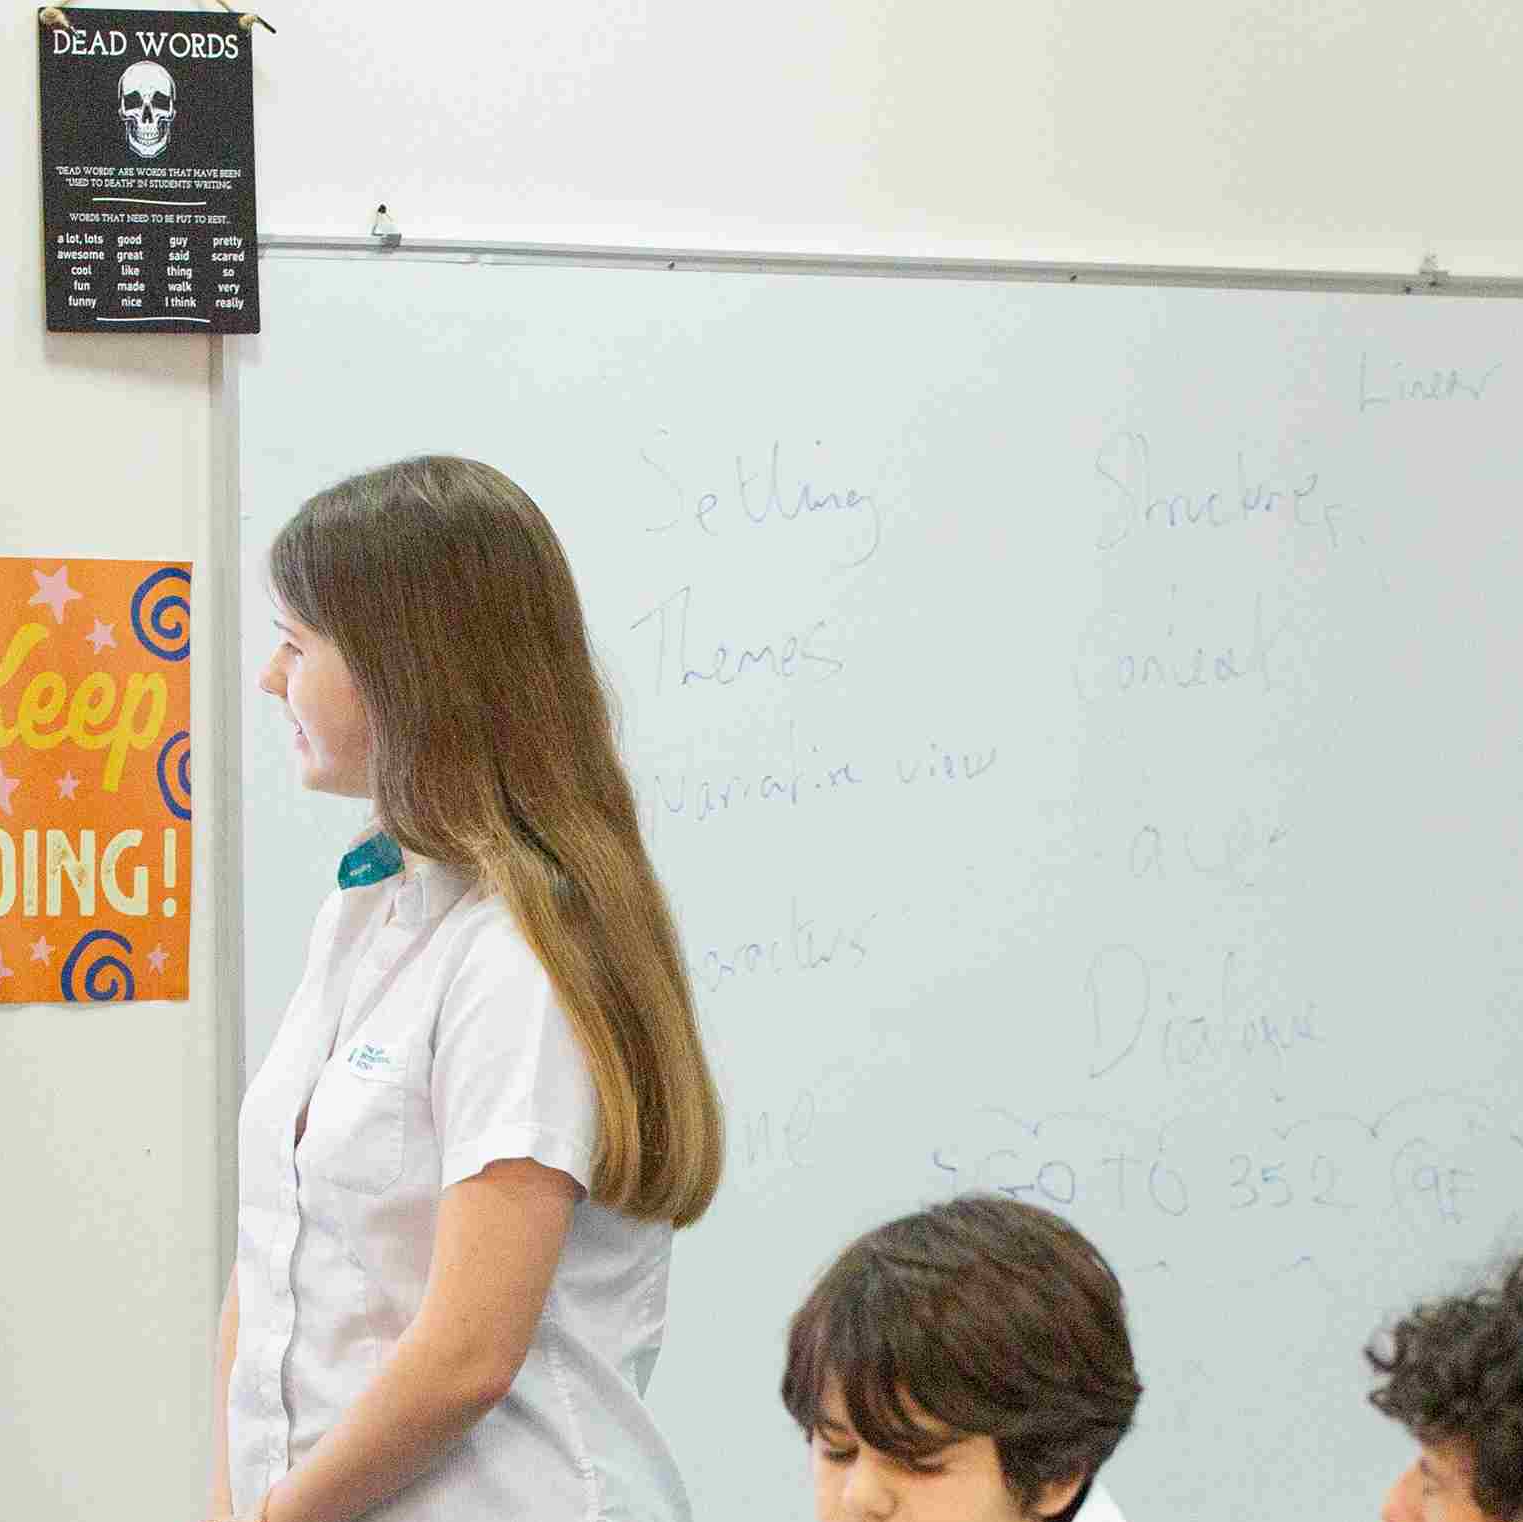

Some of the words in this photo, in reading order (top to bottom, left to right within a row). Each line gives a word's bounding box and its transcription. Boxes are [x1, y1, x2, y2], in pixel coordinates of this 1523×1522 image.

[53, 31, 127, 56] DEAD
[136, 32, 238, 59] WORDS
[169, 168, 191, 177] THAT
[90, 179, 102, 187] TO
[70, 213, 100, 222] WORDS
[102, 214, 125, 222] THAT
[165, 215, 175, 223] BE
[176, 215, 193, 223] PUT
[58, 235, 64, 243] a
[84, 234, 103, 244] lots
[118, 234, 142, 247] good
[170, 237, 188, 248] guy
[213, 236, 242, 248] pretty
[57, 251, 104, 260] awesome
[117, 251, 143, 263] great
[169, 250, 189, 261] said
[212, 251, 244, 261] scared
[71, 265, 91, 275] cool
[122, 265, 140, 276] like
[167, 266, 192, 279] thing
[74, 280, 90, 290] fun
[118, 281, 145, 291] made
[168, 282, 192, 292] walk
[218, 284, 240, 294] very
[69, 296, 96, 308] funny
[122, 297, 142, 307] nice
[171, 297, 196, 307] think
[216, 298, 244, 310] really
